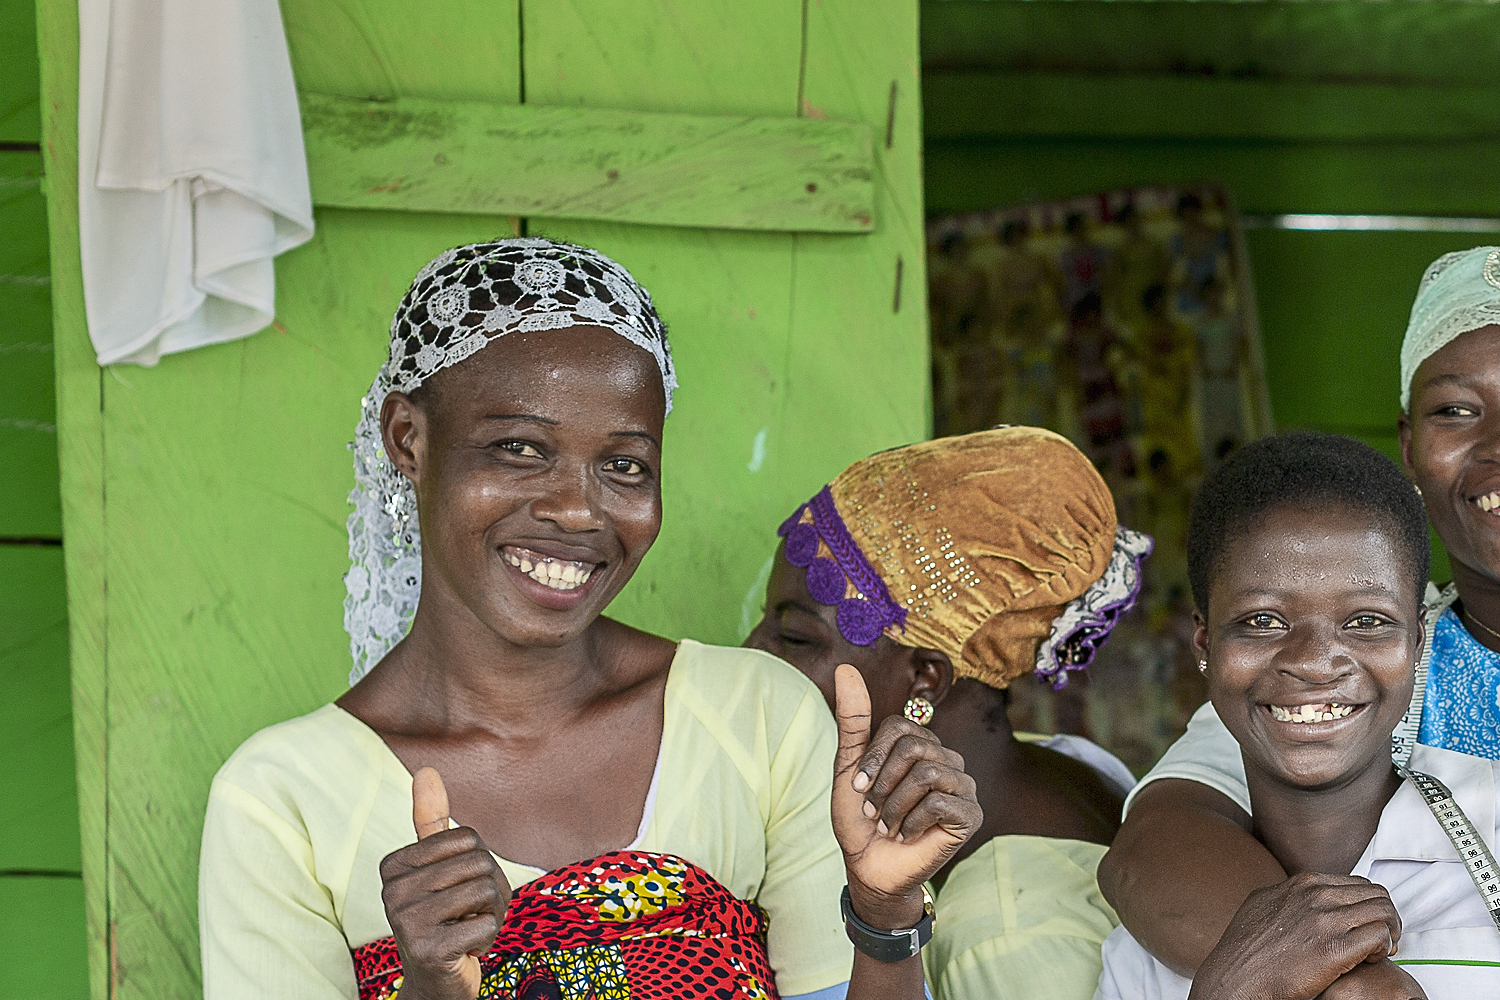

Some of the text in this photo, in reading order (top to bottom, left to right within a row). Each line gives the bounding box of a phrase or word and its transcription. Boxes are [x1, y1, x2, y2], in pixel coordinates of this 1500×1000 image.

[1438, 803, 1448, 811] 91
[1443, 811, 1453, 819] 92
[1449, 820, 1460, 828] 93
[1455, 829, 1466, 837] 94
[1461, 838, 1472, 847] 95
[1467, 849, 1478, 858] 96
[1473, 859, 1484, 869] 97
[1480, 871, 1491, 881] 98
[1487, 883, 1498, 893] 99
